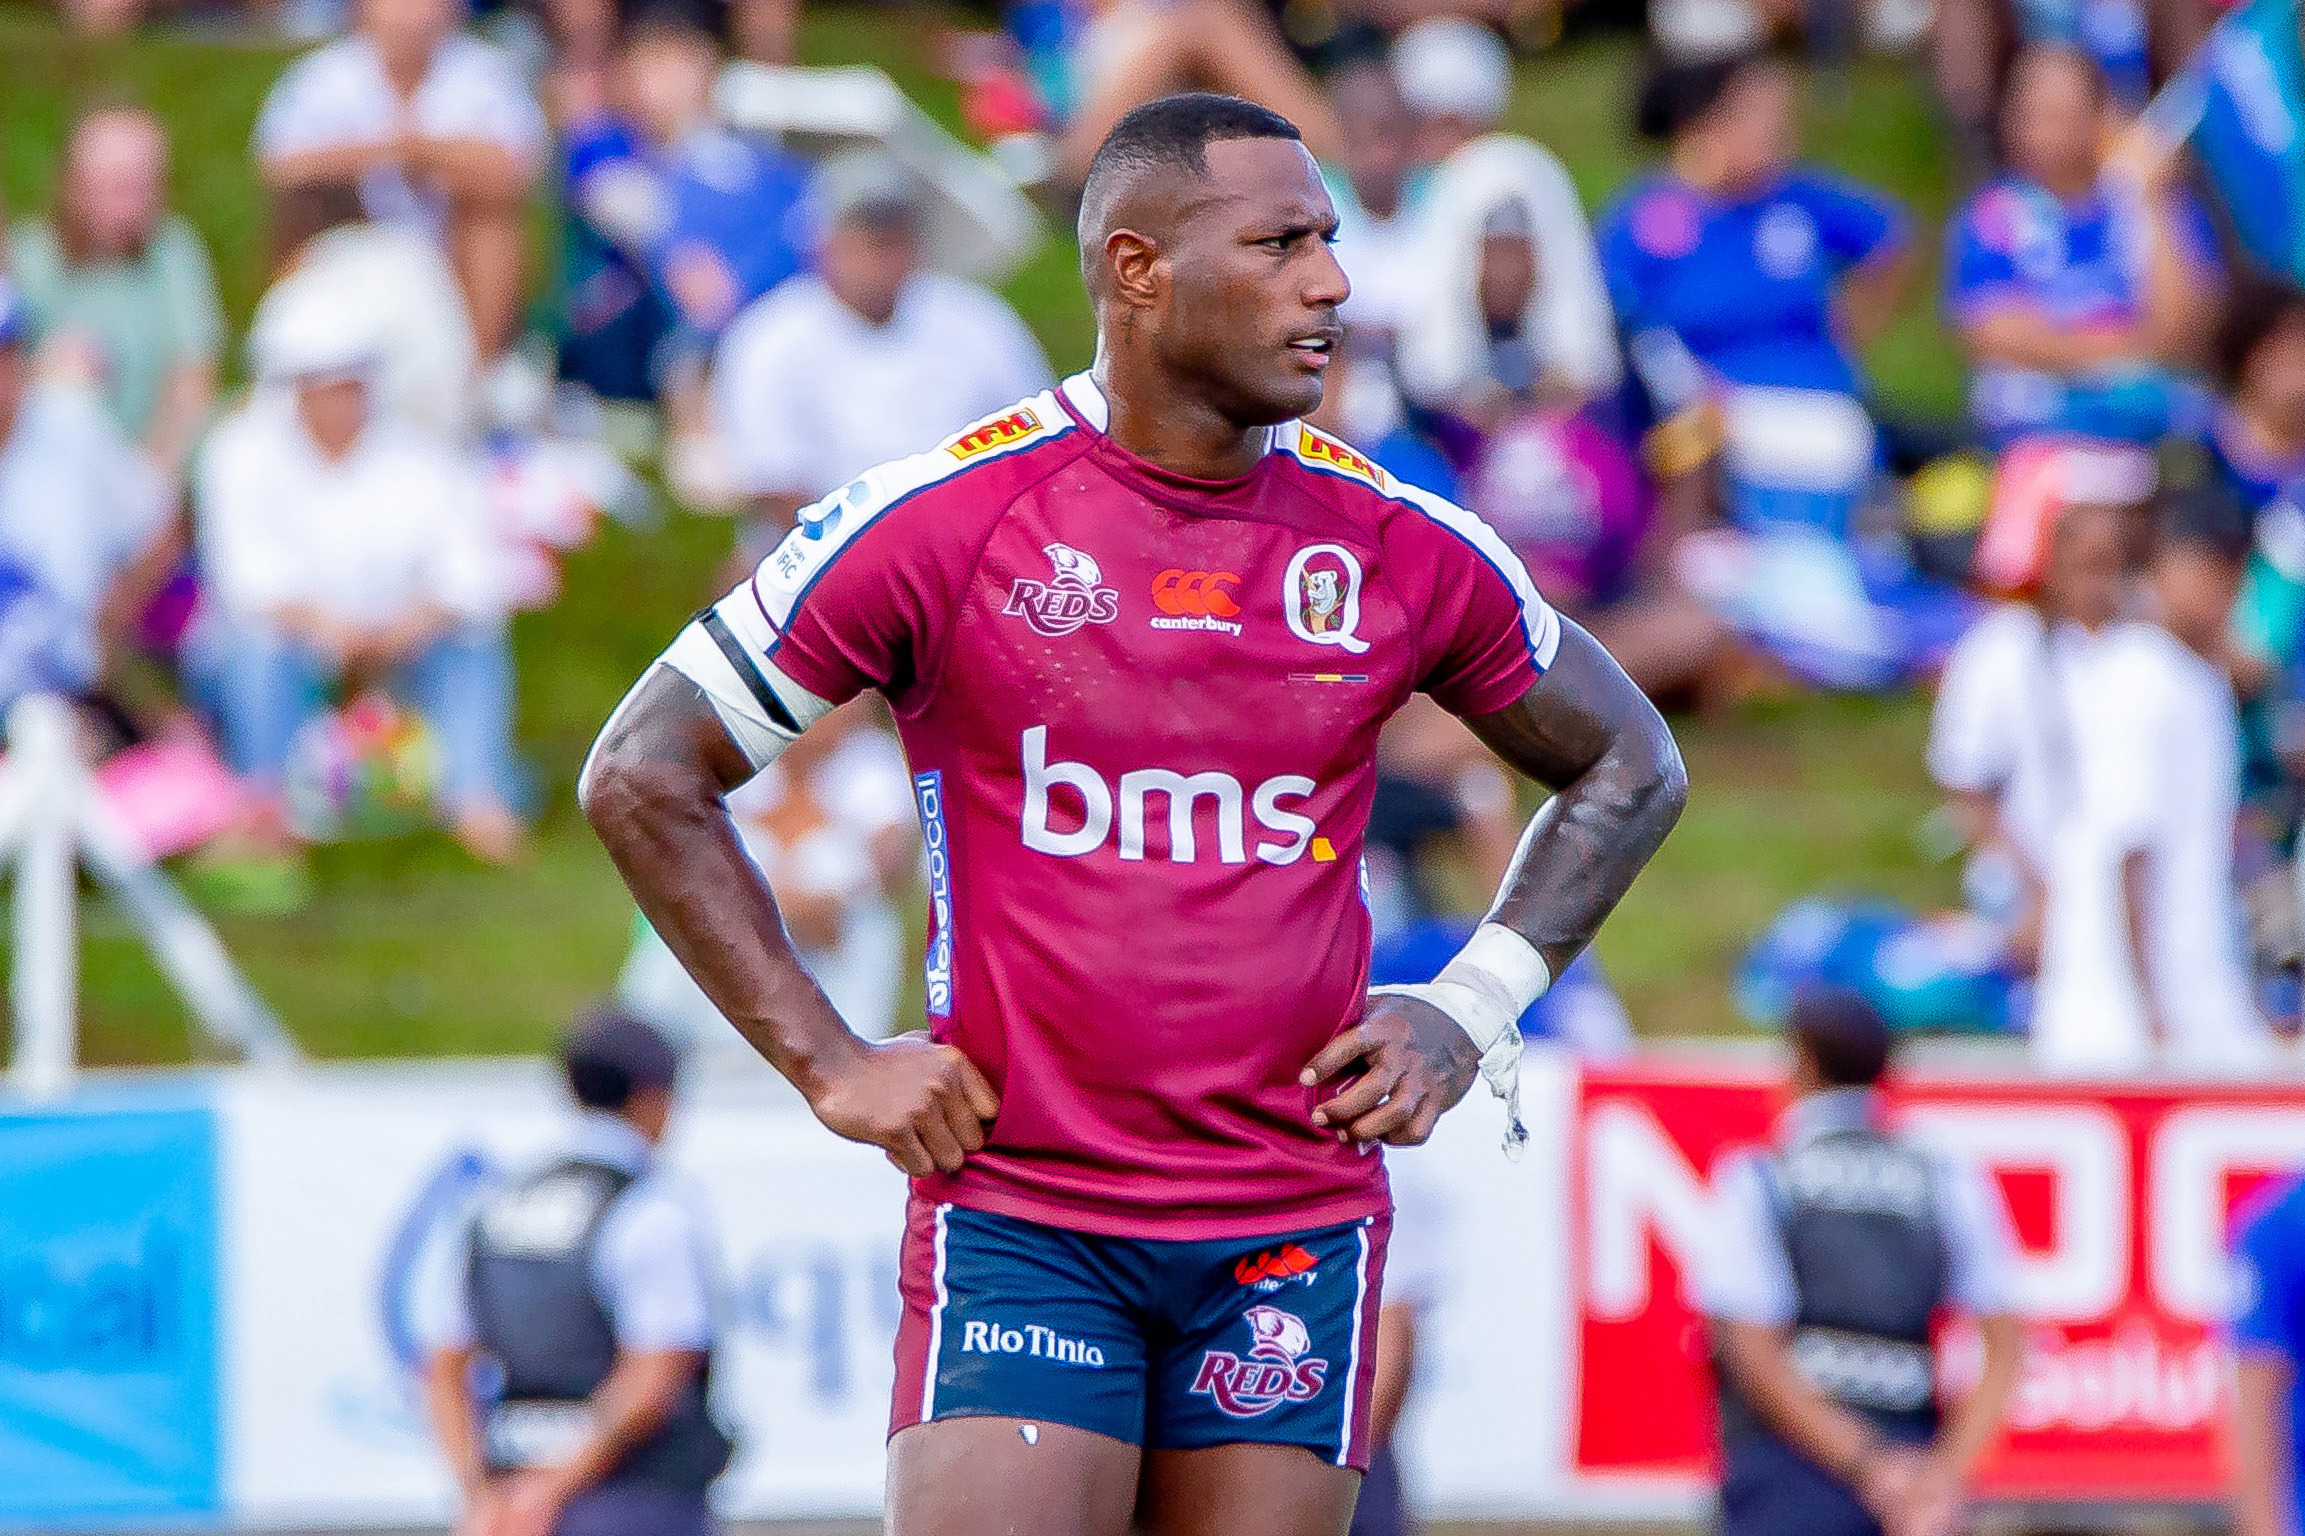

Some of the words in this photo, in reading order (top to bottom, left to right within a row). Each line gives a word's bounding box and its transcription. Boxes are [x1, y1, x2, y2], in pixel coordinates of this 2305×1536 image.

[1001, 577, 1121, 637] REDS
[1149, 615, 1243, 638] canterbury
[1283, 543, 1372, 655] Q
[961, 1320, 1024, 1354] Rio
[1024, 1323, 1105, 1367] Tinto
[1190, 1350, 1329, 1418] REDS
